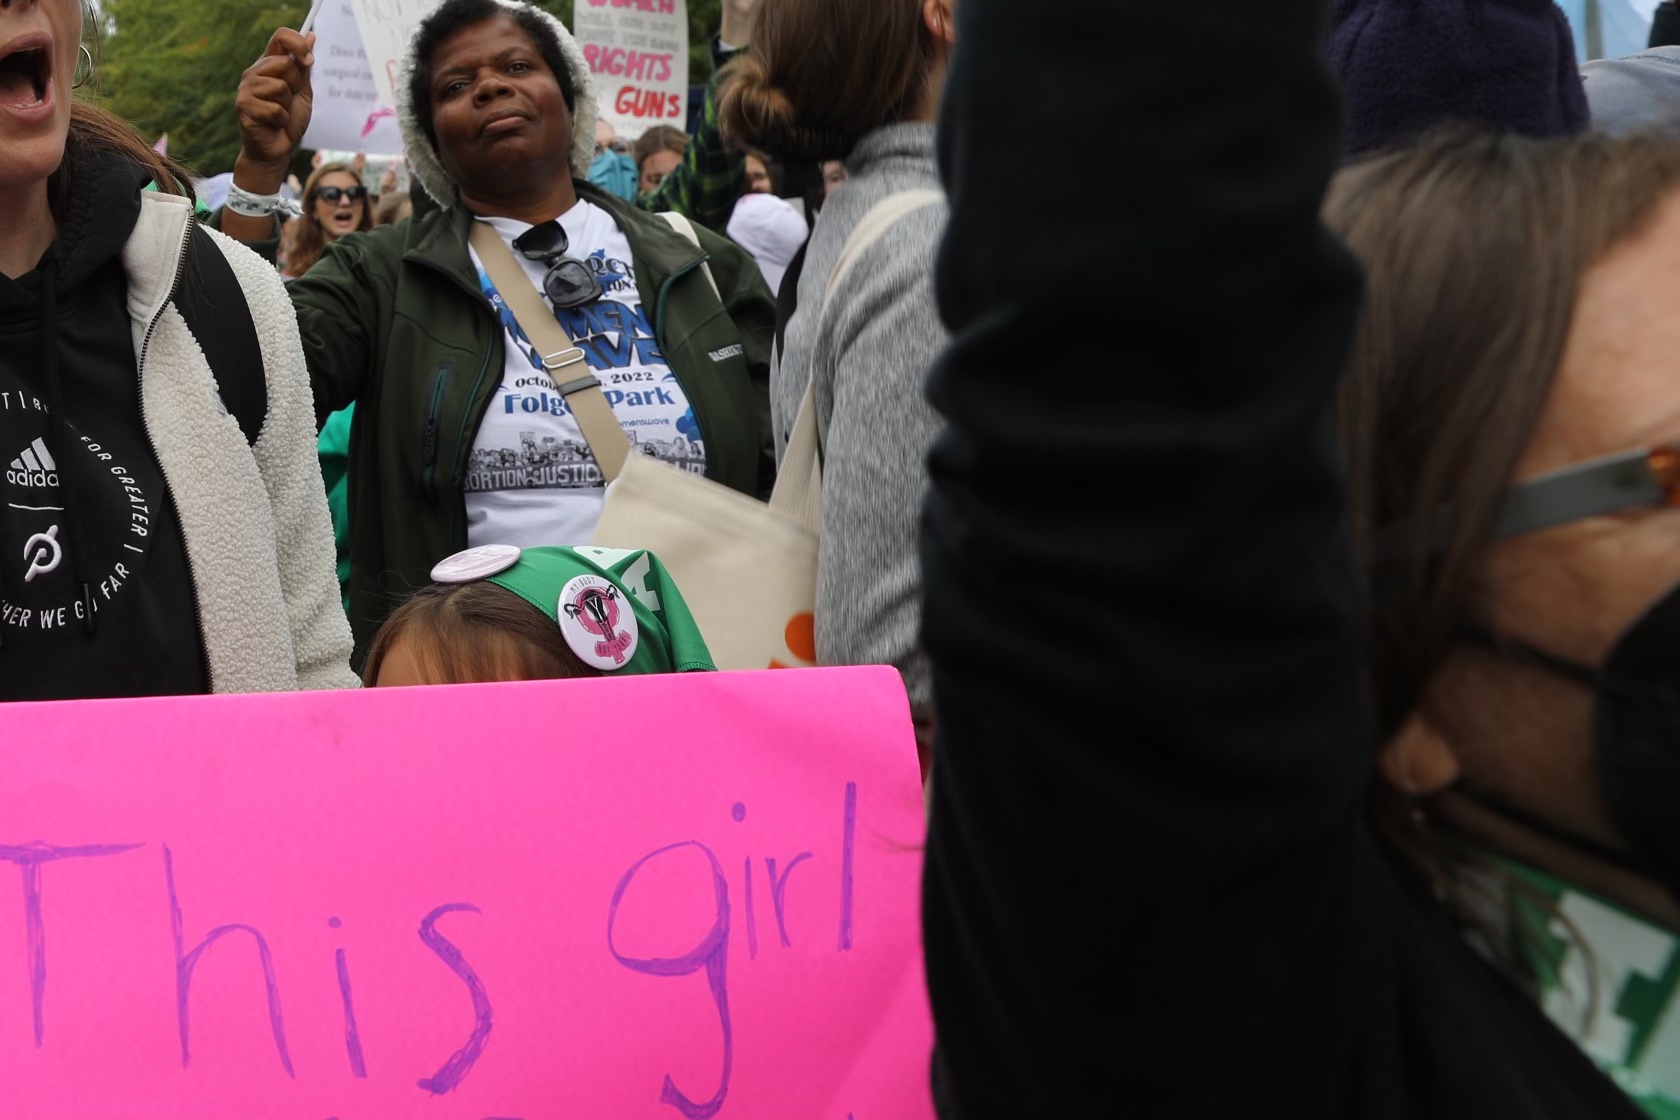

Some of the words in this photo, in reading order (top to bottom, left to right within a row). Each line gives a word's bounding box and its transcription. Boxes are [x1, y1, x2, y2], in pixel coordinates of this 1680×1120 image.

[583, 44, 673, 81] RIGHTS
[615, 85, 680, 118] GUNS
[611, 371, 655, 385] 2022
[504, 392, 573, 417] Folg
[604, 387, 676, 409] Park
[621, 417, 670, 429] menswave
[6, 468, 60, 487] adida
[110, 466, 150, 538] GREATER
[40, 607, 67, 630] WE
[100, 562, 131, 600] FAR
[605, 780, 858, 1119] girl
